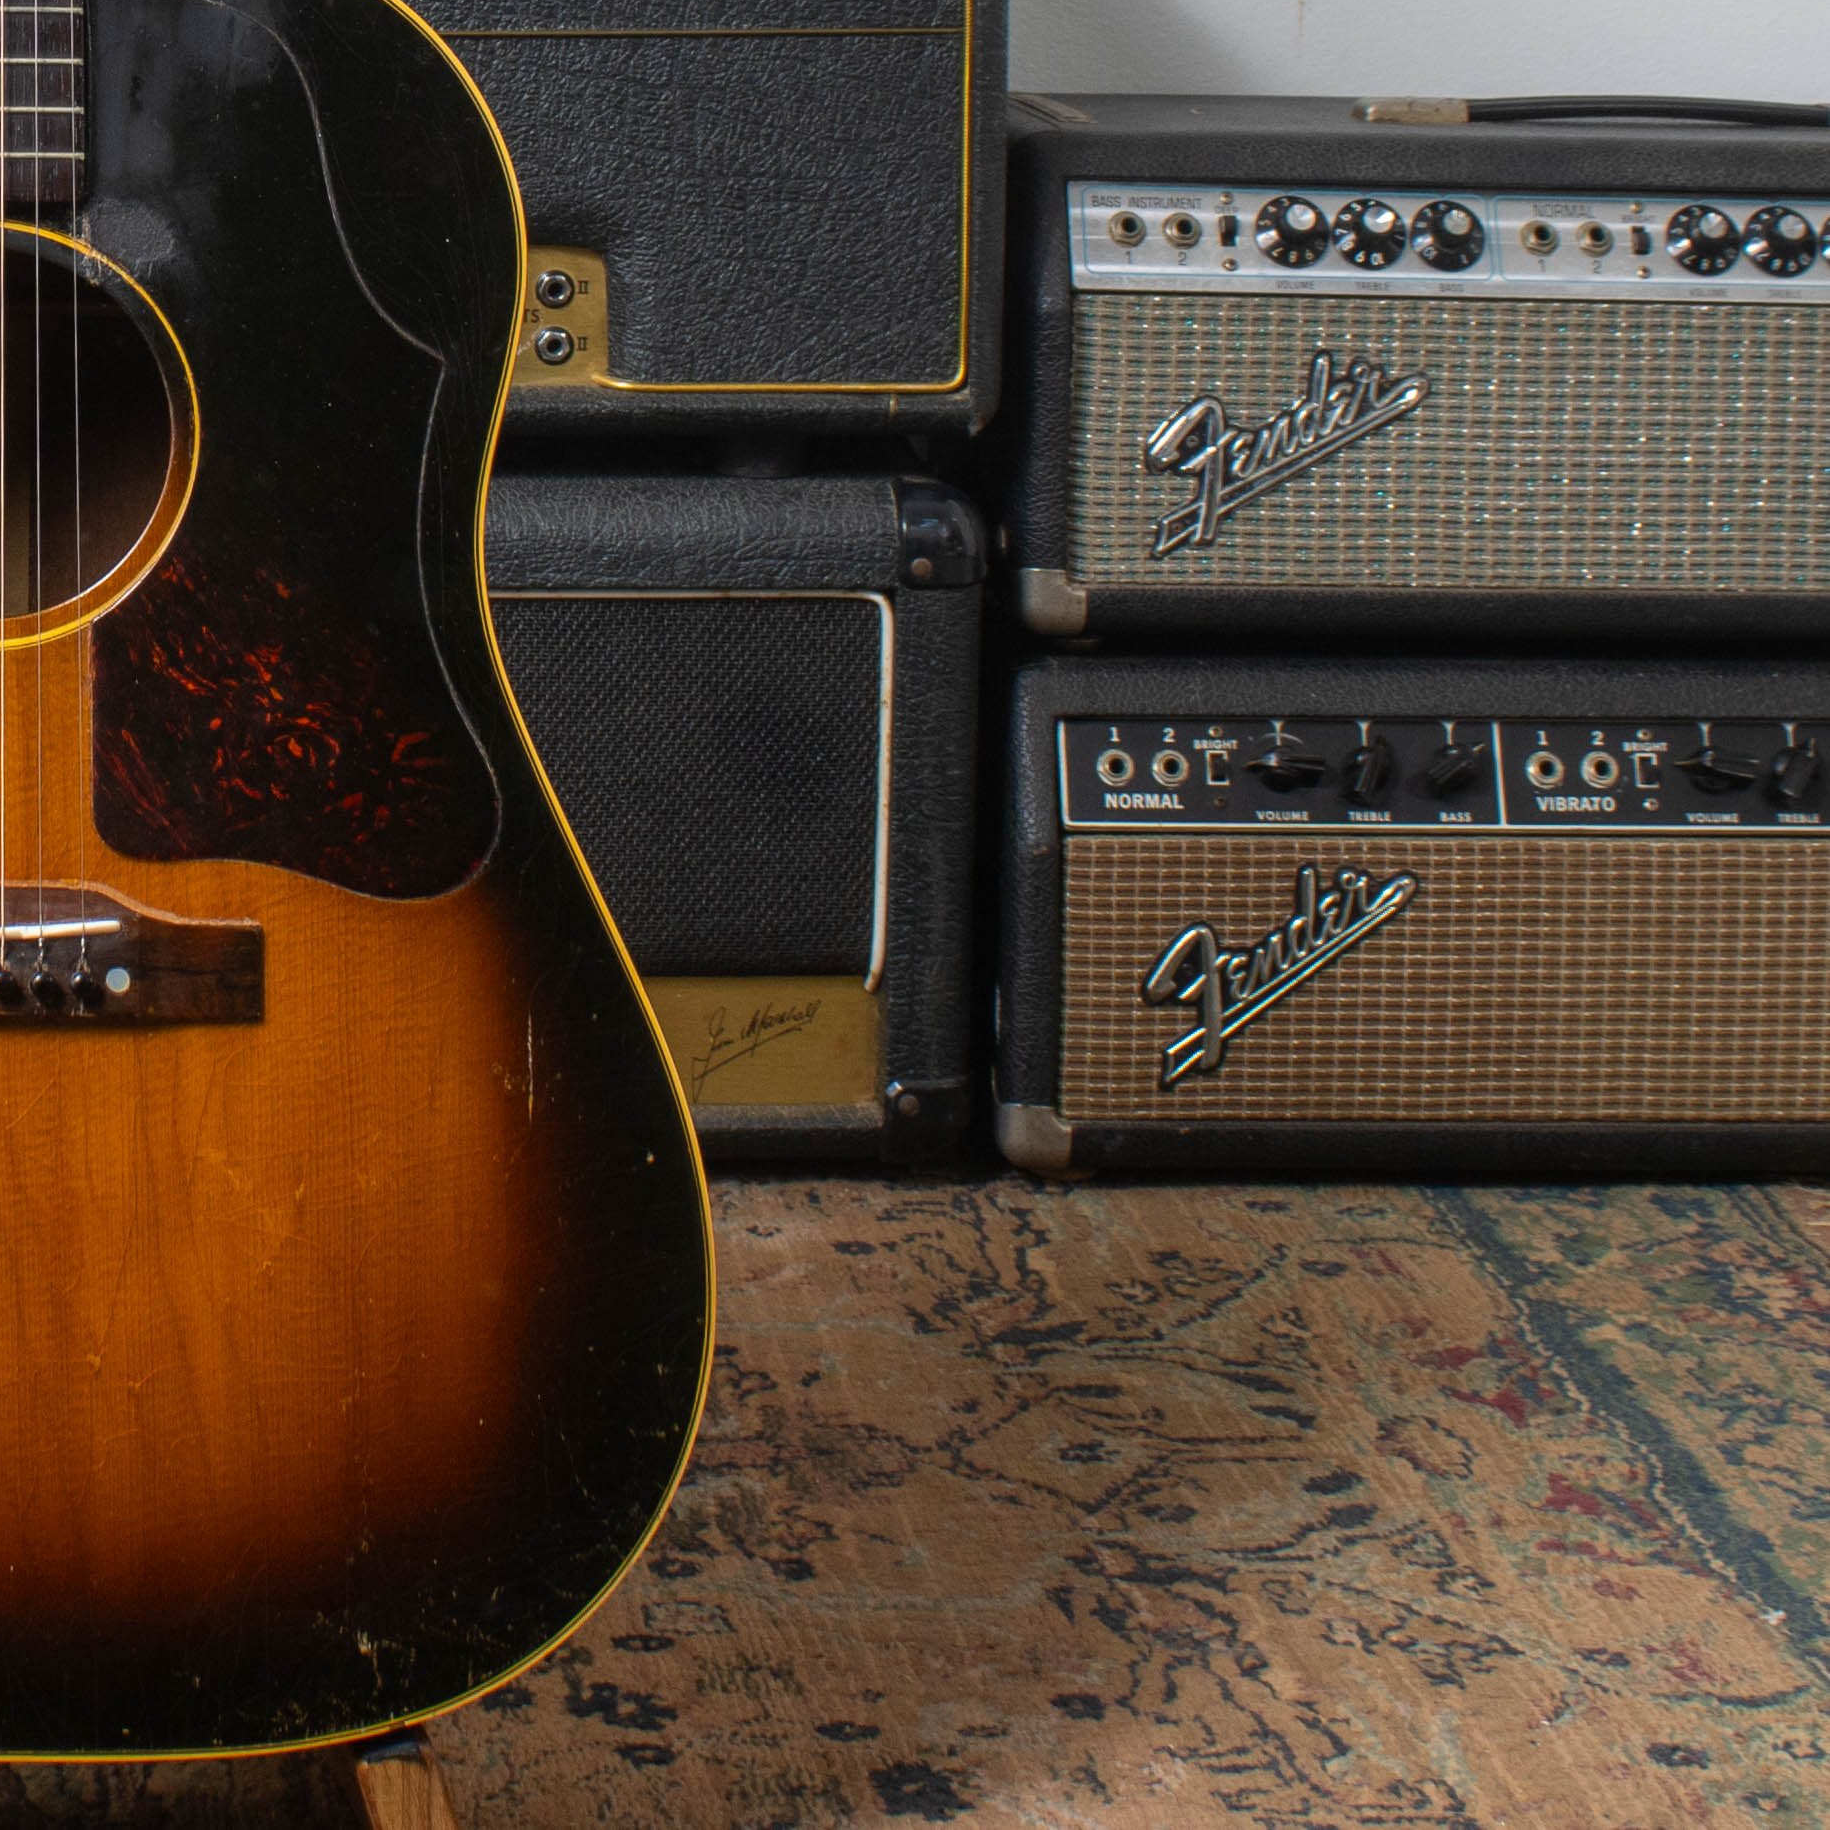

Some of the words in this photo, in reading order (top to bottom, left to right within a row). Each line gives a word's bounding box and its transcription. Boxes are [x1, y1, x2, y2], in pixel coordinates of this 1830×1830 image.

[1091, 195, 1122, 209] BASS
[1127, 196, 1202, 211] INSTRUMENT
[1144, 348, 1430, 560] Fender
[1108, 726, 1121, 743] 1
[1161, 726, 1176, 743] 2
[1536, 730, 1549, 746] 1
[1590, 730, 1605, 746] 2
[1191, 739, 1239, 750] BRIGHT
[1104, 792, 1186, 810] NORMAL
[1534, 795, 1616, 813] VIBRATO
[1255, 810, 1309, 821] VOLUME
[1348, 810, 1392, 822] TREBLE
[1438, 811, 1473, 823] BASS
[1685, 812, 1741, 824] VOLUME
[1776, 812, 1821, 824] TREBLE
[1141, 862, 1420, 1093] Fender
